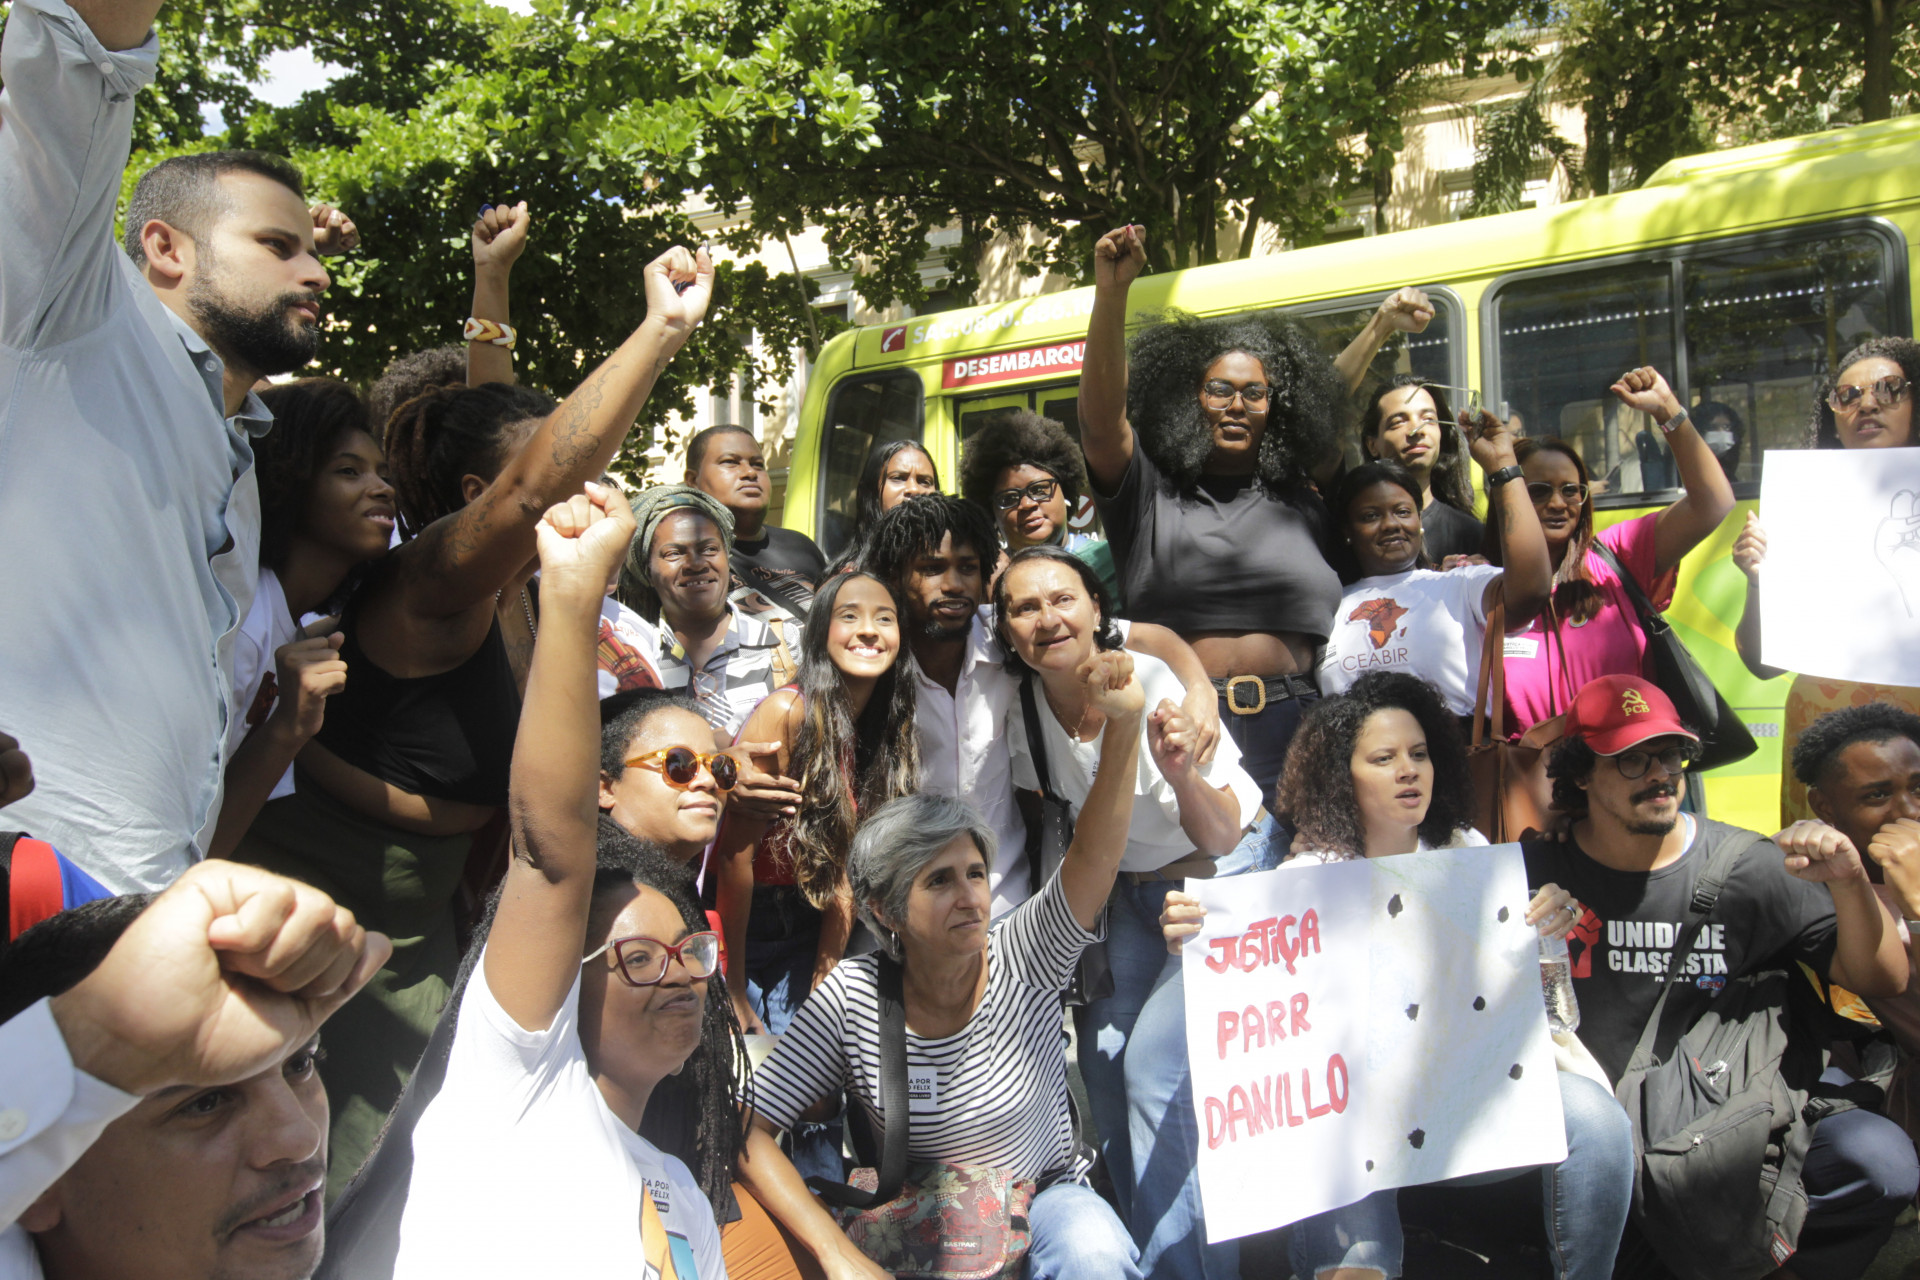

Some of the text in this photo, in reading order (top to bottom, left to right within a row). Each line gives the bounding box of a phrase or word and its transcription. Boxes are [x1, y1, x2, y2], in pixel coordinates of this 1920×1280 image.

[954, 343, 1086, 379] DESEMBARQU
[1342, 647, 1408, 671] CEABIR
[1624, 704, 1650, 717] PCB
[1607, 950, 1728, 975] CLASSSTA
[1699, 980, 1724, 988] FSM
[913, 1083, 931, 1091] FÉLIX
[1204, 1052, 1349, 1150] DANILLO
[654, 1179, 670, 1191] POR
[649, 1187, 670, 1200] FÉLIX
